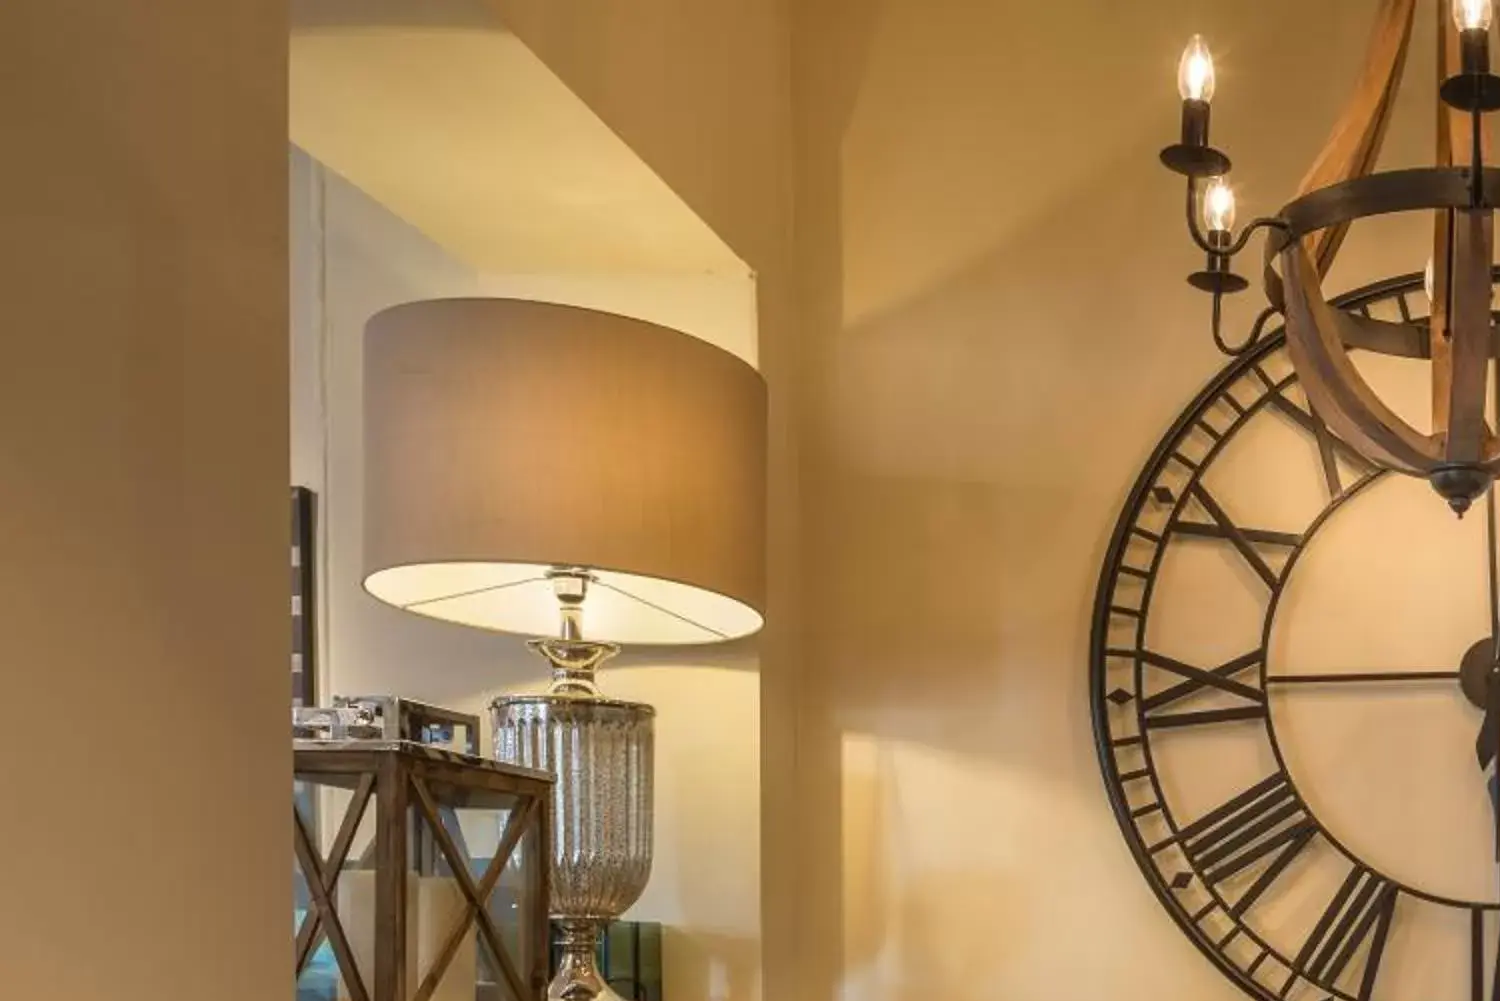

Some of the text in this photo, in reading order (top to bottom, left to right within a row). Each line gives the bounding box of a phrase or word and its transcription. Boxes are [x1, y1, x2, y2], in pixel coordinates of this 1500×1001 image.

[1170, 478, 1303, 590] X
[1138, 648, 1268, 728] IX
[1176, 770, 1319, 919] VIII
